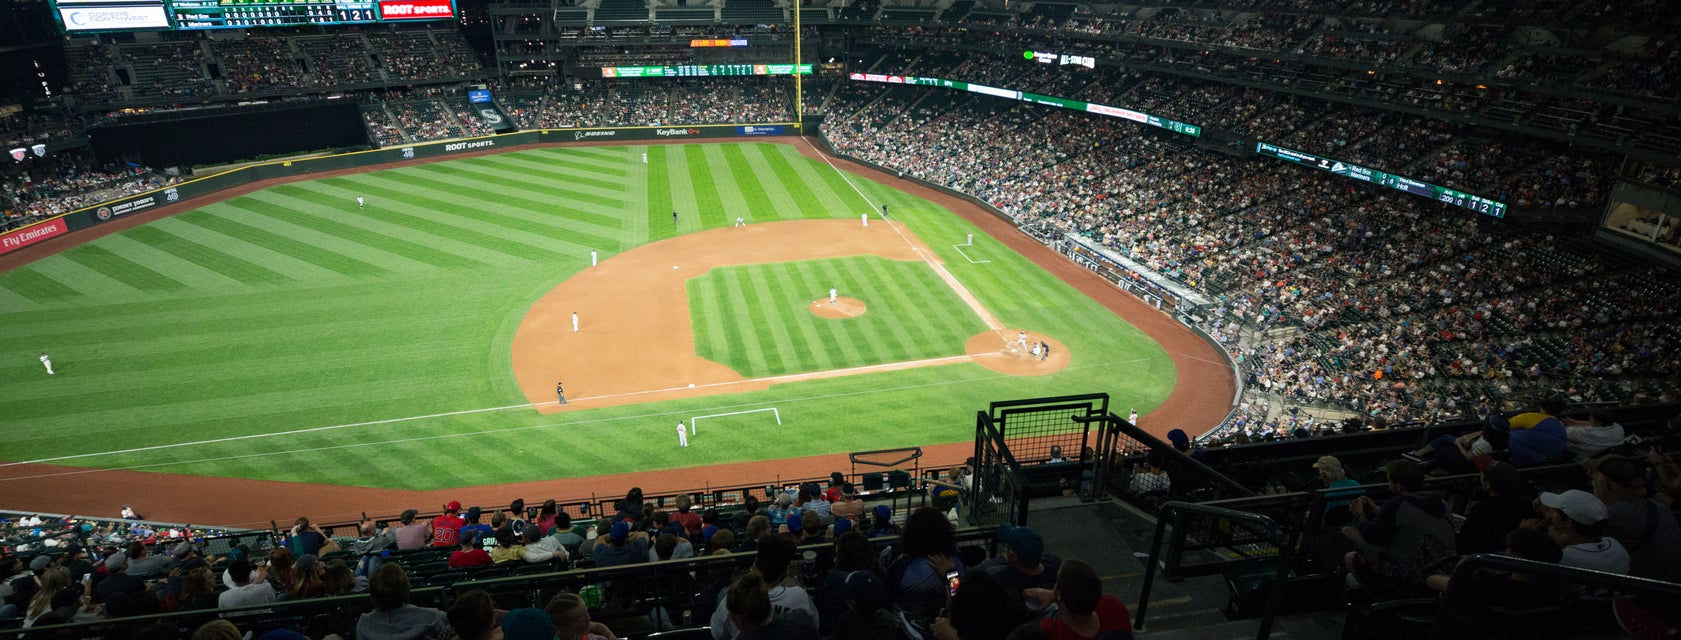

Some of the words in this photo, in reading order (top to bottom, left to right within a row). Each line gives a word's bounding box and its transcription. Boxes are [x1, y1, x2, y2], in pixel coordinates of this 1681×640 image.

[383, 4, 414, 15] ROOT
[340, 11, 346, 20] 1
[352, 10, 360, 20] 2
[366, 10, 372, 19] 1
[657, 128, 688, 136] KeyBank
[445, 142, 467, 151] ROOT
[1350, 171, 1371, 181] Mariners
[1352, 166, 1362, 174] Red
[1362, 168, 1372, 176] Sox
[1397, 183, 1409, 191] Holt
[112, 202, 132, 213] JIMMY
[1481, 204, 1488, 213] 2
[2, 237, 20, 247] Fly
[19, 224, 57, 242] Emirates
[434, 528, 454, 543] 20
[482, 537, 498, 546] GRIF
